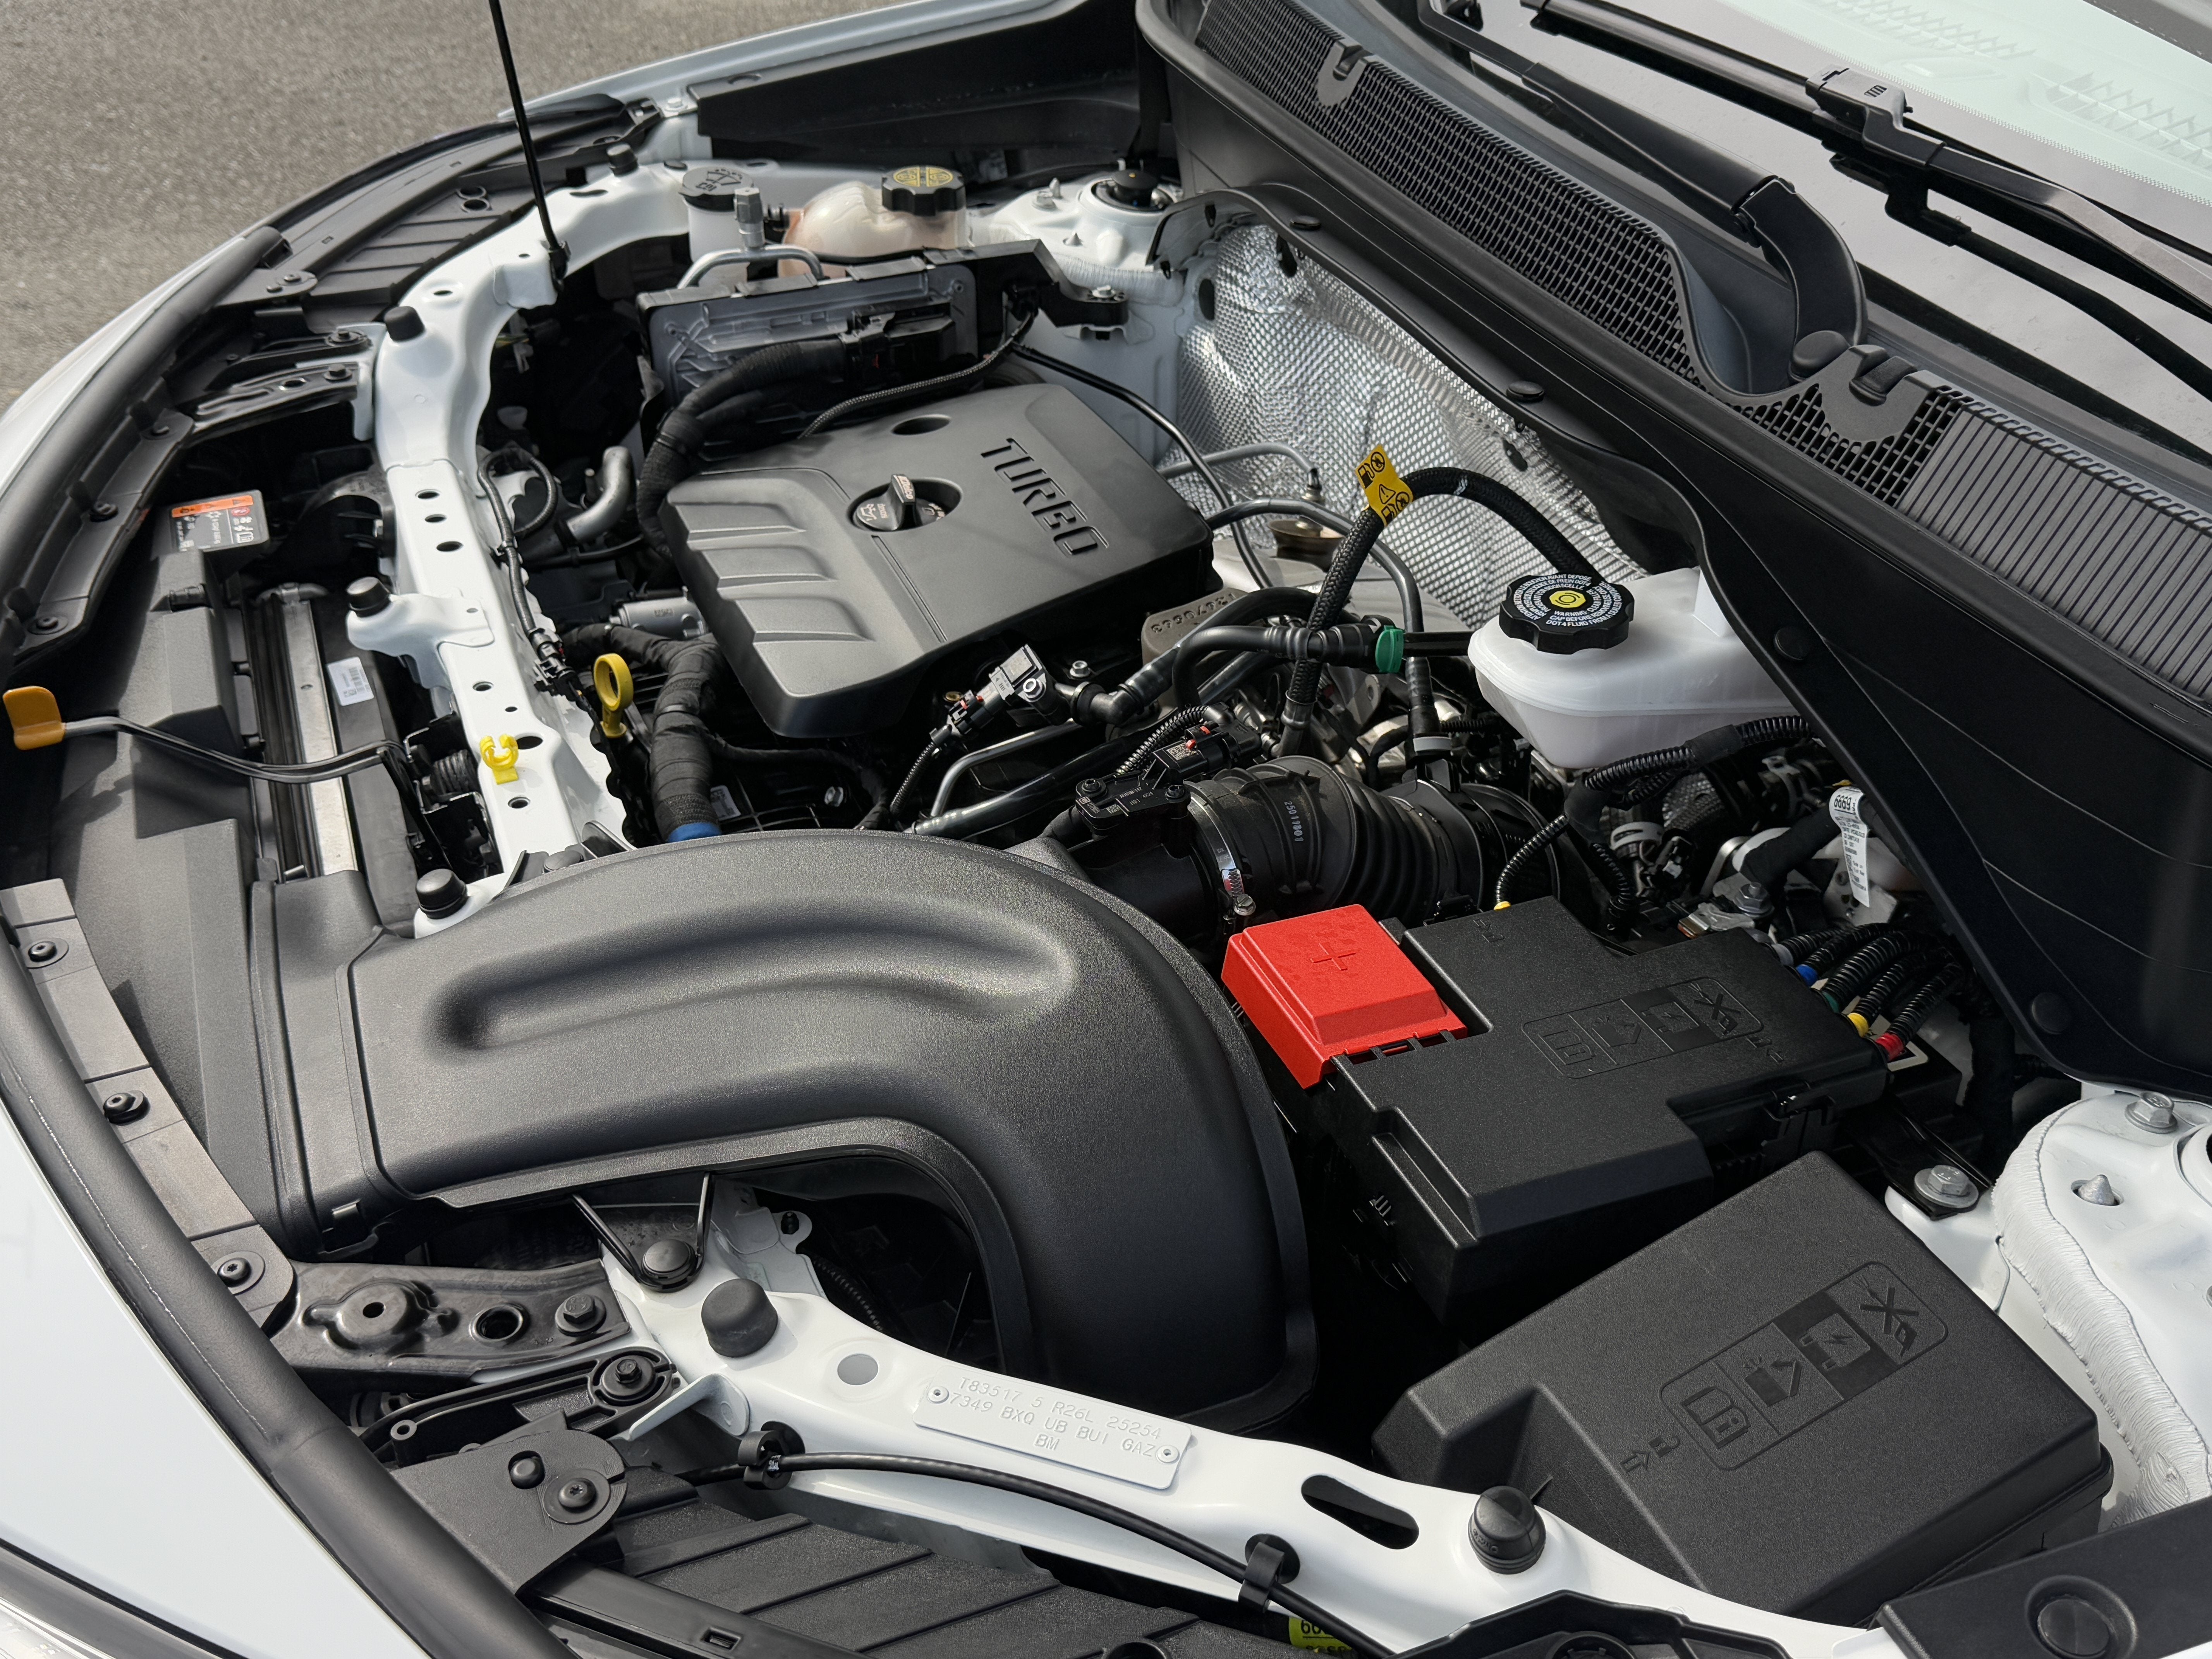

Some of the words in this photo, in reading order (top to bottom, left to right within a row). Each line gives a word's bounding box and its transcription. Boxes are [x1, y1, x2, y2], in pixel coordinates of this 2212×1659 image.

[981, 437, 1109, 558] TURBO
[1592, 586, 1607, 594] ONLY
[1589, 616, 1606, 625] FROM
[1608, 601, 1623, 615] SEALED
[1834, 794, 1851, 811] 6669
[960, 1377, 1022, 1402] T83517
[1031, 1396, 1043, 1408] 5
[1052, 1401, 1093, 1422] R26L
[1106, 1416, 1161, 1440] 25254
[950, 1393, 993, 1412] 7349
[1000, 1406, 1035, 1425] BXQ
[1045, 1417, 1068, 1433] UB
[1122, 1438, 1156, 1457] GAZ
[1034, 1434, 1060, 1450] BM
